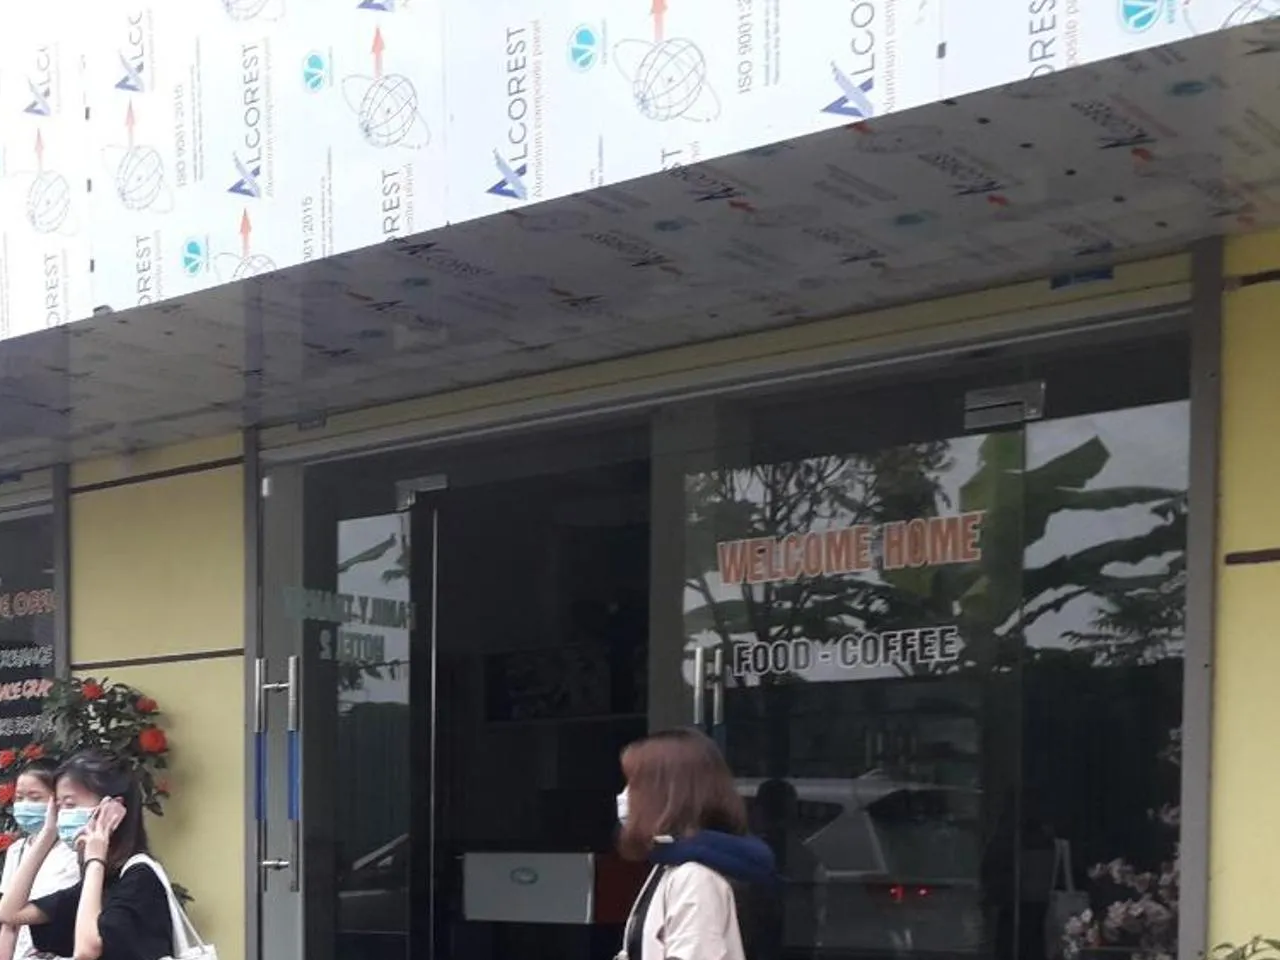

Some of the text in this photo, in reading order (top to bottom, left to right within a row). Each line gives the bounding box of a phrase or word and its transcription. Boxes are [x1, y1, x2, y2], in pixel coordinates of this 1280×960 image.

[226, 43, 261, 200] ALCOREST
[484, 26, 529, 200] ALCOREST
[717, 511, 986, 585] WELCOME HOME
[732, 637, 813, 678] FOOD
[837, 626, 959, 669] COFFEE
